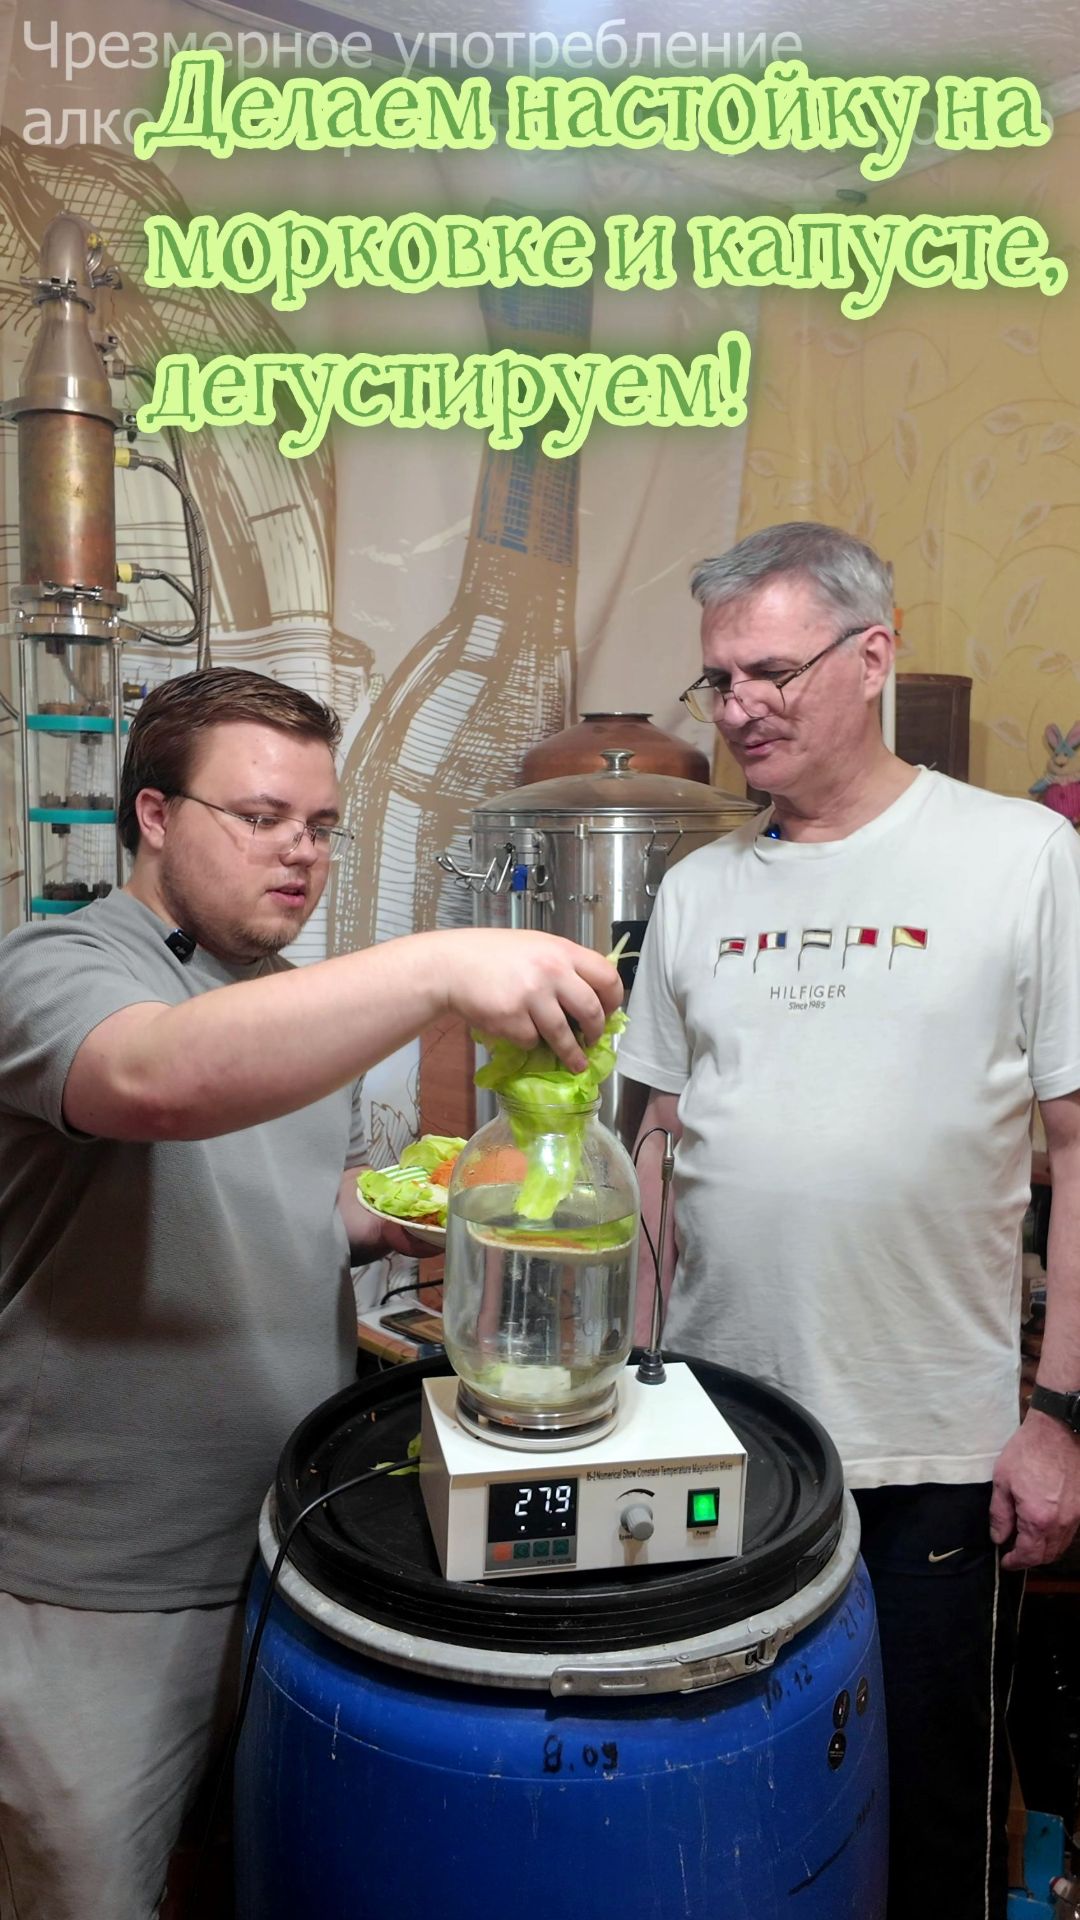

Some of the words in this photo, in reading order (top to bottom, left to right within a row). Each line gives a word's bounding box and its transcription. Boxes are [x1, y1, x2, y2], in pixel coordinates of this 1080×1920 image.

[770, 984, 847, 1000] HILFIGER
[788, 1001, 808, 1011] Since
[809, 1000, 826, 1009] 1985
[514, 1485, 571, 1516] 27.9
